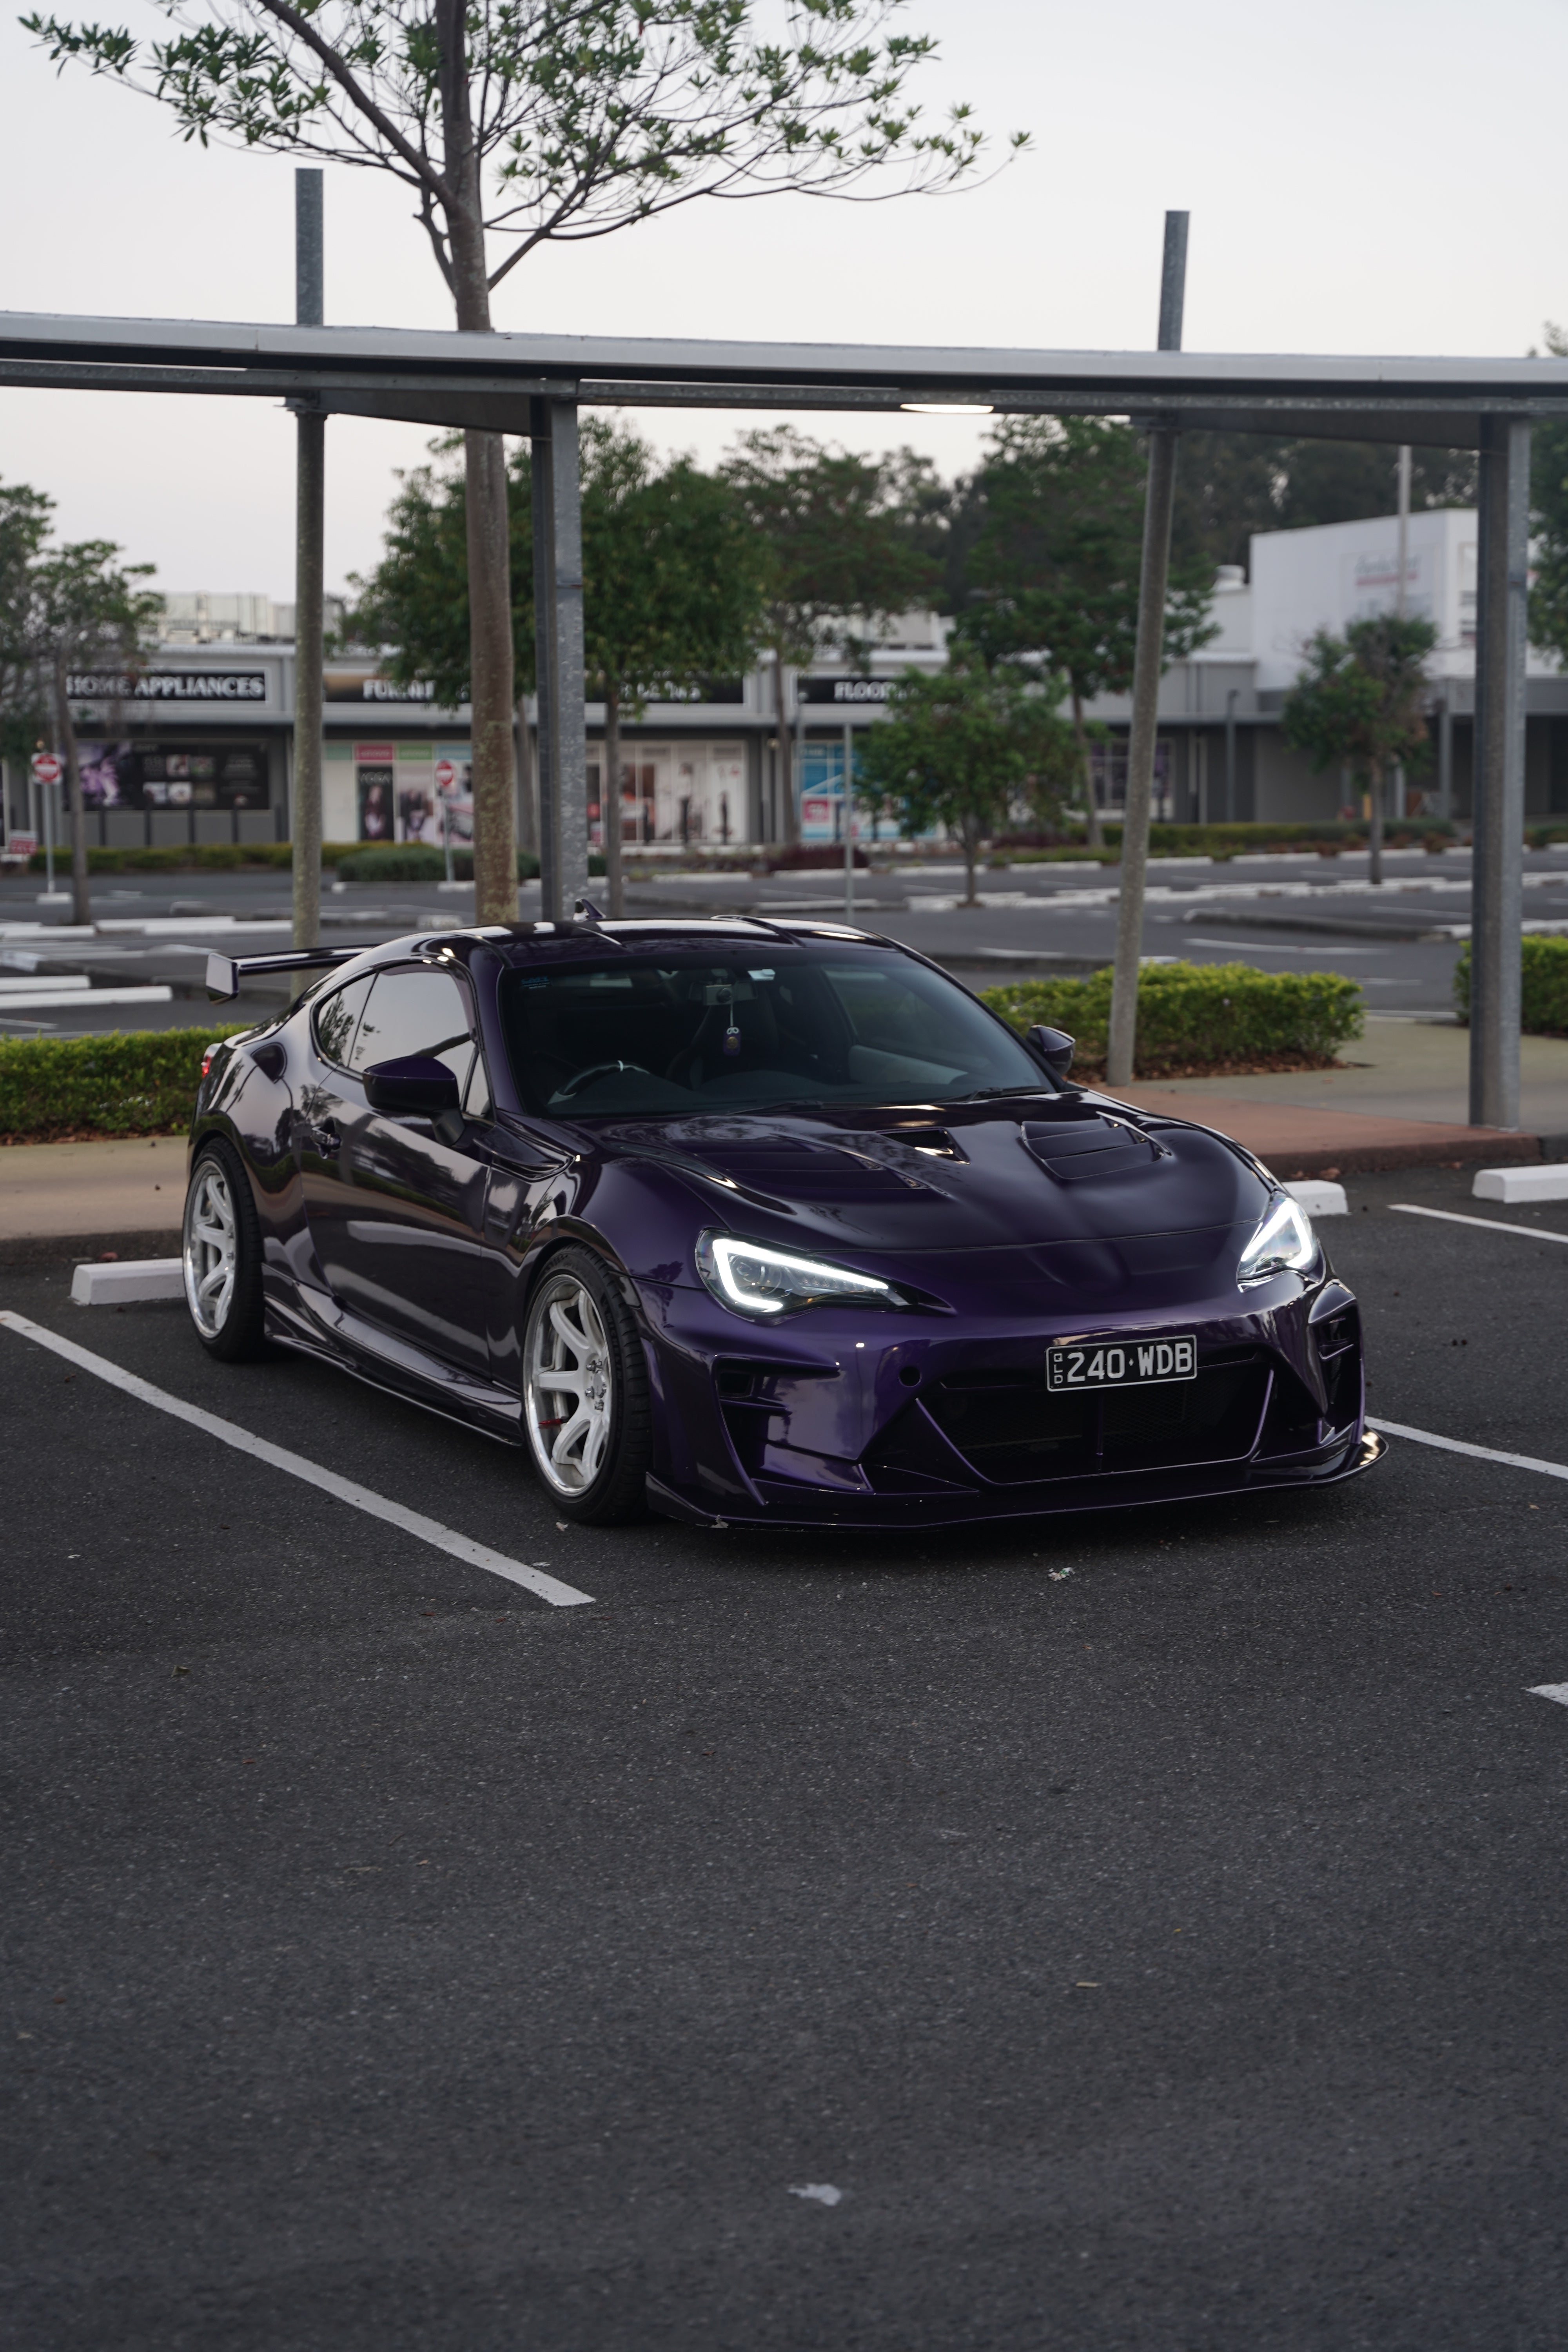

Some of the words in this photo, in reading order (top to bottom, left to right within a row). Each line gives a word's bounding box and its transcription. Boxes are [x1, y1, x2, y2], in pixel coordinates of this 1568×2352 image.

[65, 675, 132, 697] HOME
[134, 676, 265, 697] APPLIANCES
[606, 1313, 622, 1379] MICHELIN
[1053, 1353, 1063, 1384] QLD
